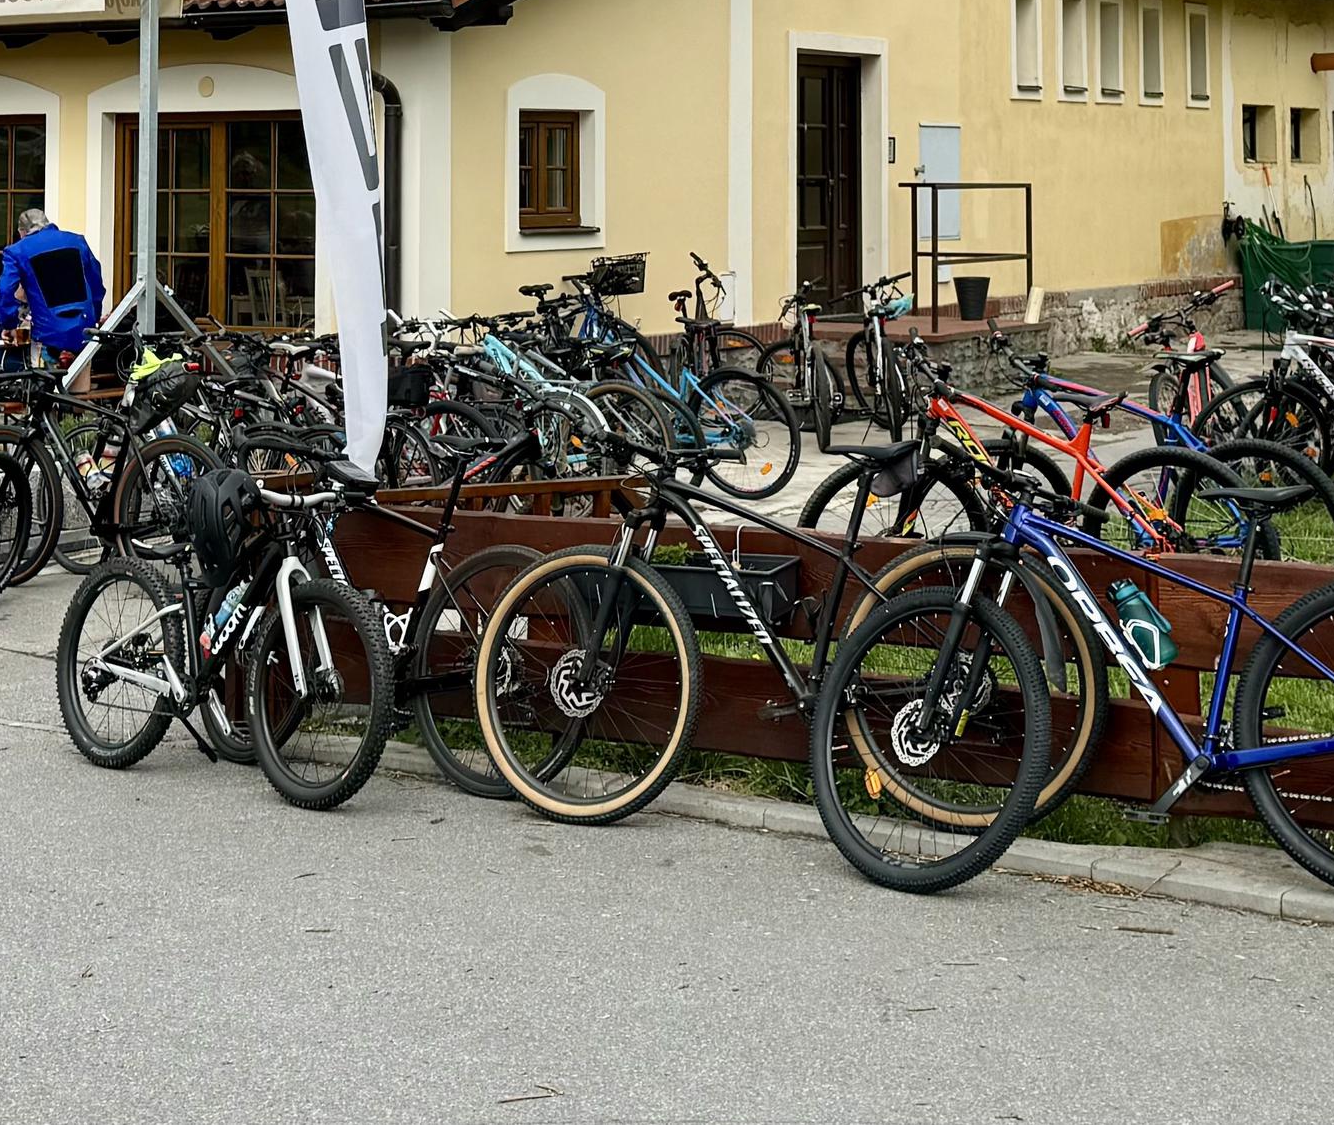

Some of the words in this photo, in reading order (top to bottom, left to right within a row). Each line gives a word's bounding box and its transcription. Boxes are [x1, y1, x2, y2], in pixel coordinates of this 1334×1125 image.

[211, 602, 248, 655] woom
[692, 524, 773, 644] SPECIALIZED
[1047, 556, 1163, 716] ORBEA
